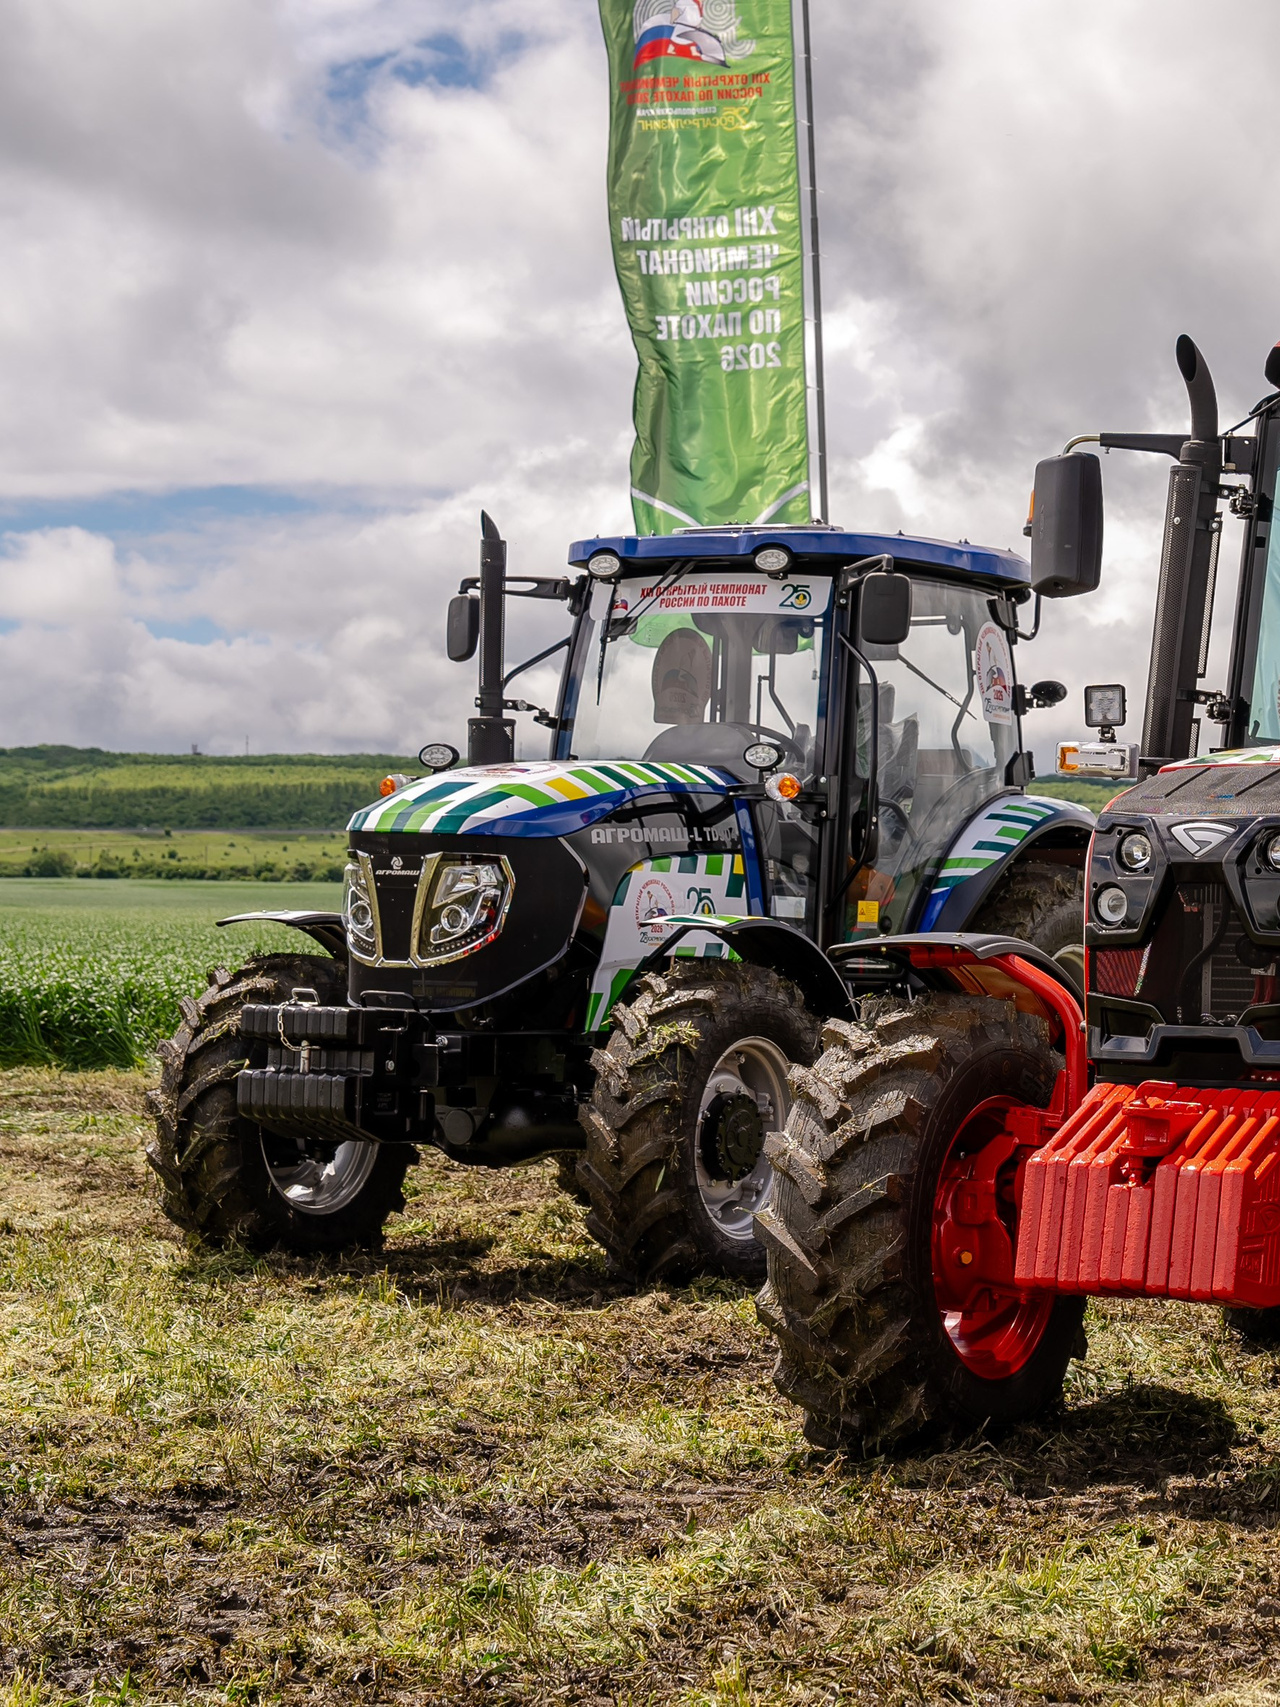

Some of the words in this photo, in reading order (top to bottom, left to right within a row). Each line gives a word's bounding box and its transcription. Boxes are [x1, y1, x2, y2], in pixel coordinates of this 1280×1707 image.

[709, 584, 768, 595] ЧЕМПИОНАТ
[659, 596, 695, 609] РОССИИ
[697, 597, 710, 607] ПО
[711, 596, 747, 607] ПАХОТЕ
[778, 583, 812, 610] 25
